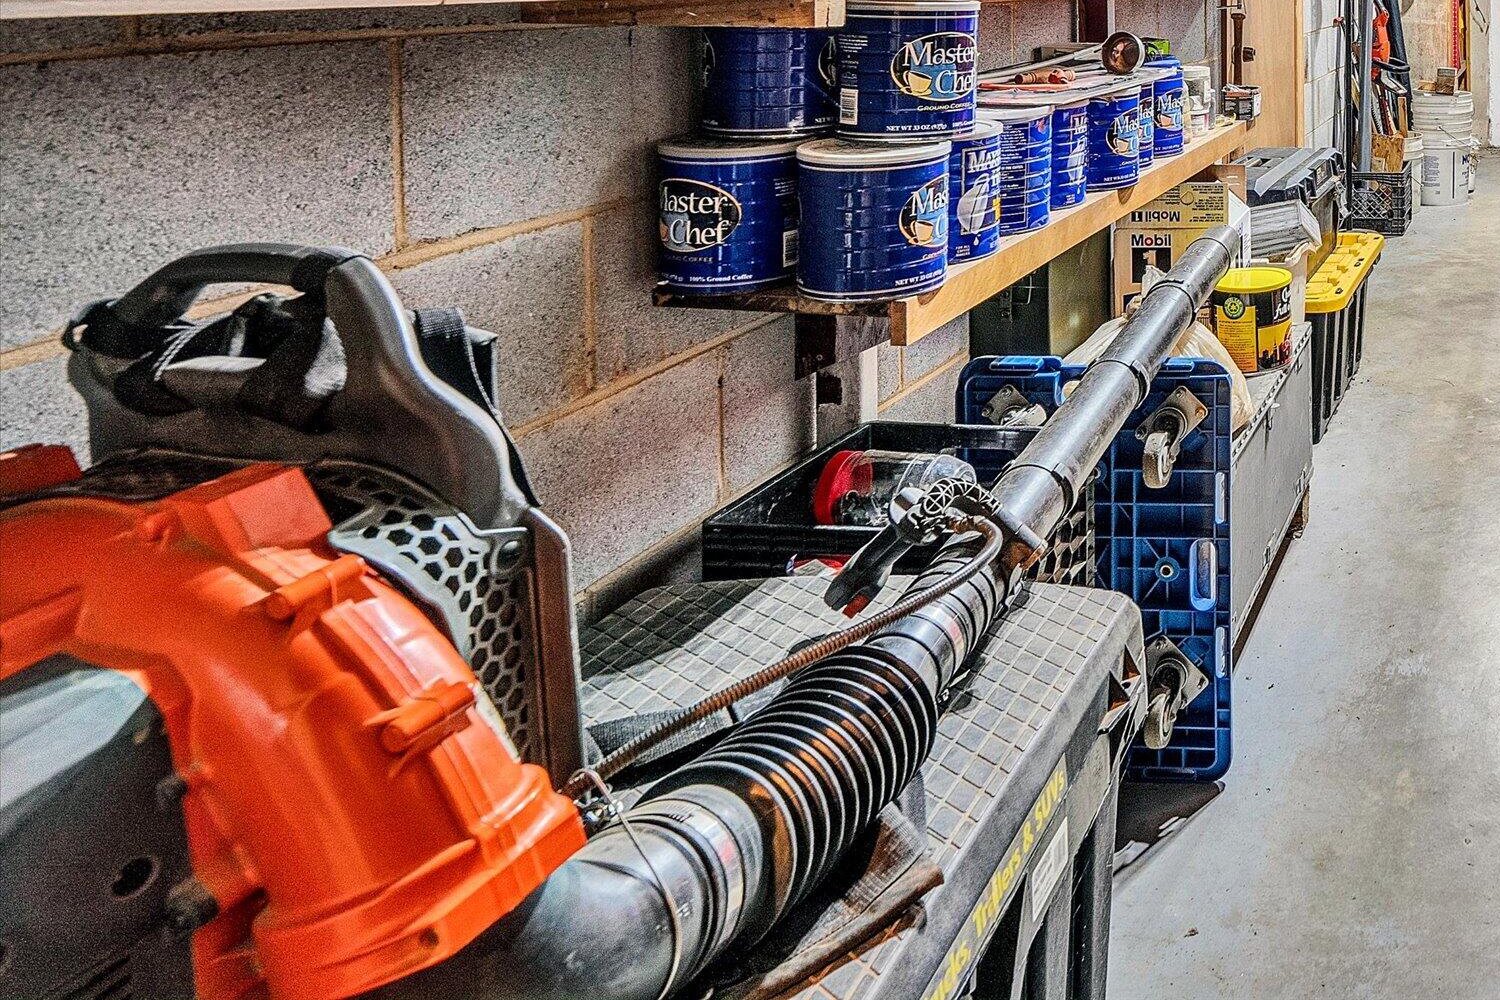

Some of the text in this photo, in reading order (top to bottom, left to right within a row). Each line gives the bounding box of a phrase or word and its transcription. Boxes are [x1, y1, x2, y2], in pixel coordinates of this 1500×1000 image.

[903, 41, 977, 66] Master
[911, 187, 949, 217] Mas
[1145, 211, 1180, 223] Mobil
[669, 218, 731, 245] Chef
[1131, 233, 1171, 247] Mobil
[972, 848, 1021, 937] Trailers
